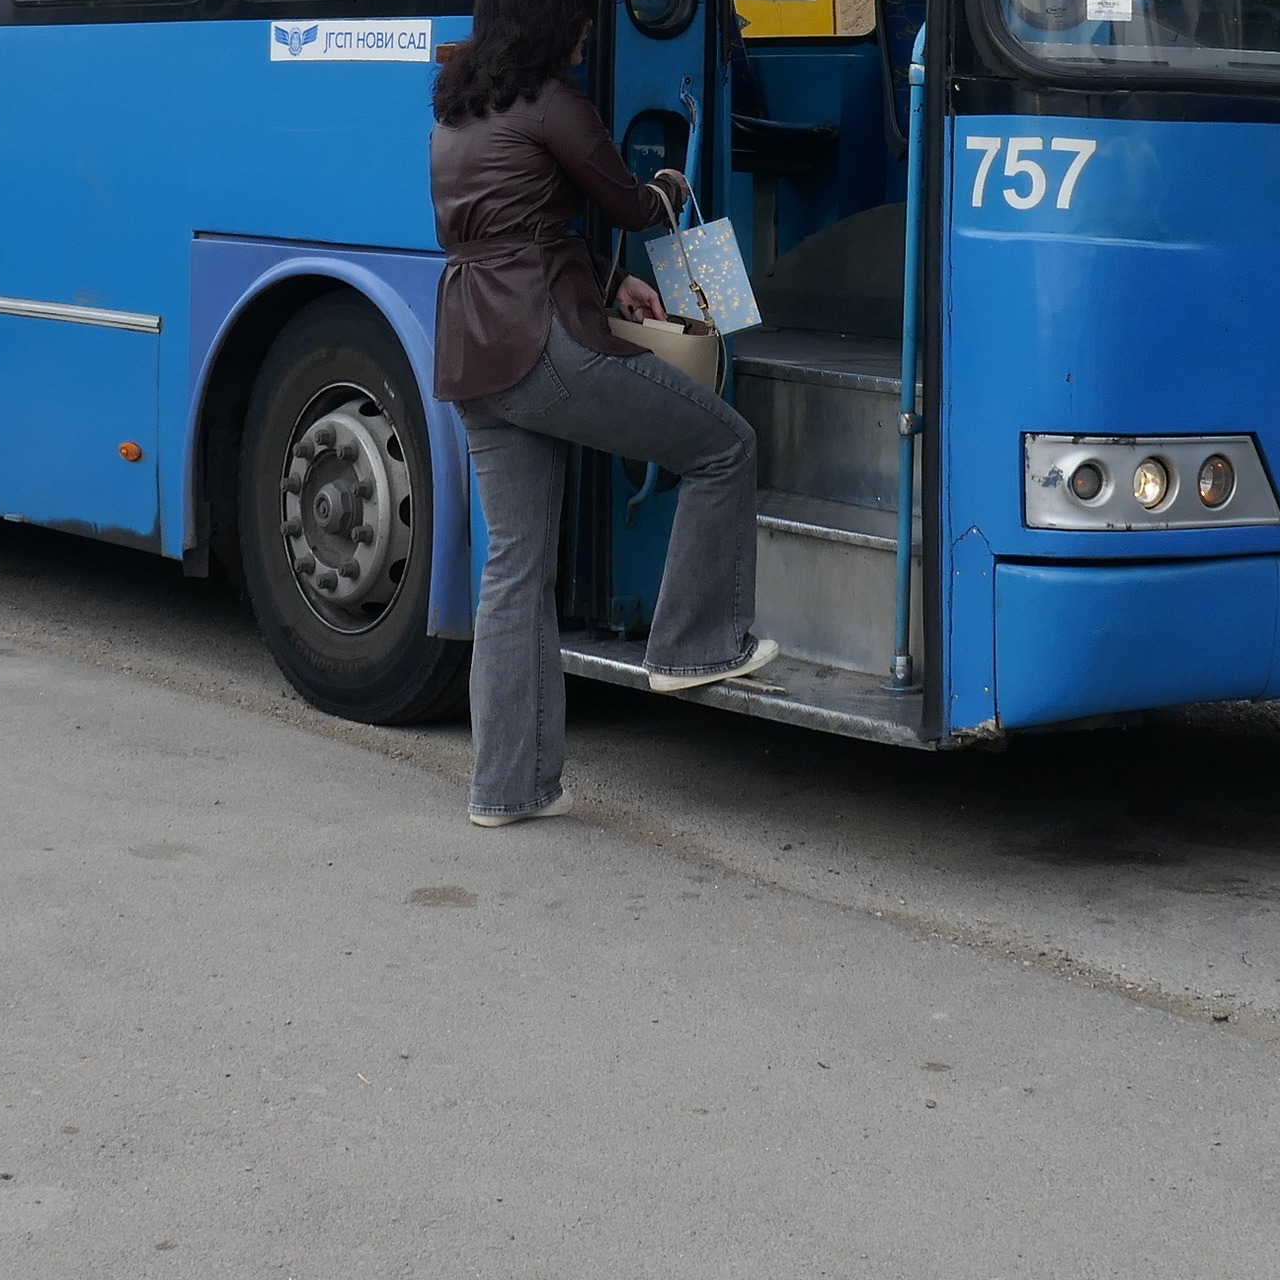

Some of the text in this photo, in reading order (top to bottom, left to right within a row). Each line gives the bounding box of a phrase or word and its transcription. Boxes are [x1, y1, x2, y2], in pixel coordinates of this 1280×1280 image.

[323, 32, 353, 53] ЈГСП
[356, 32, 394, 49] НОВИ
[397, 32, 427, 50] САД
[966, 136, 1097, 210] 757
